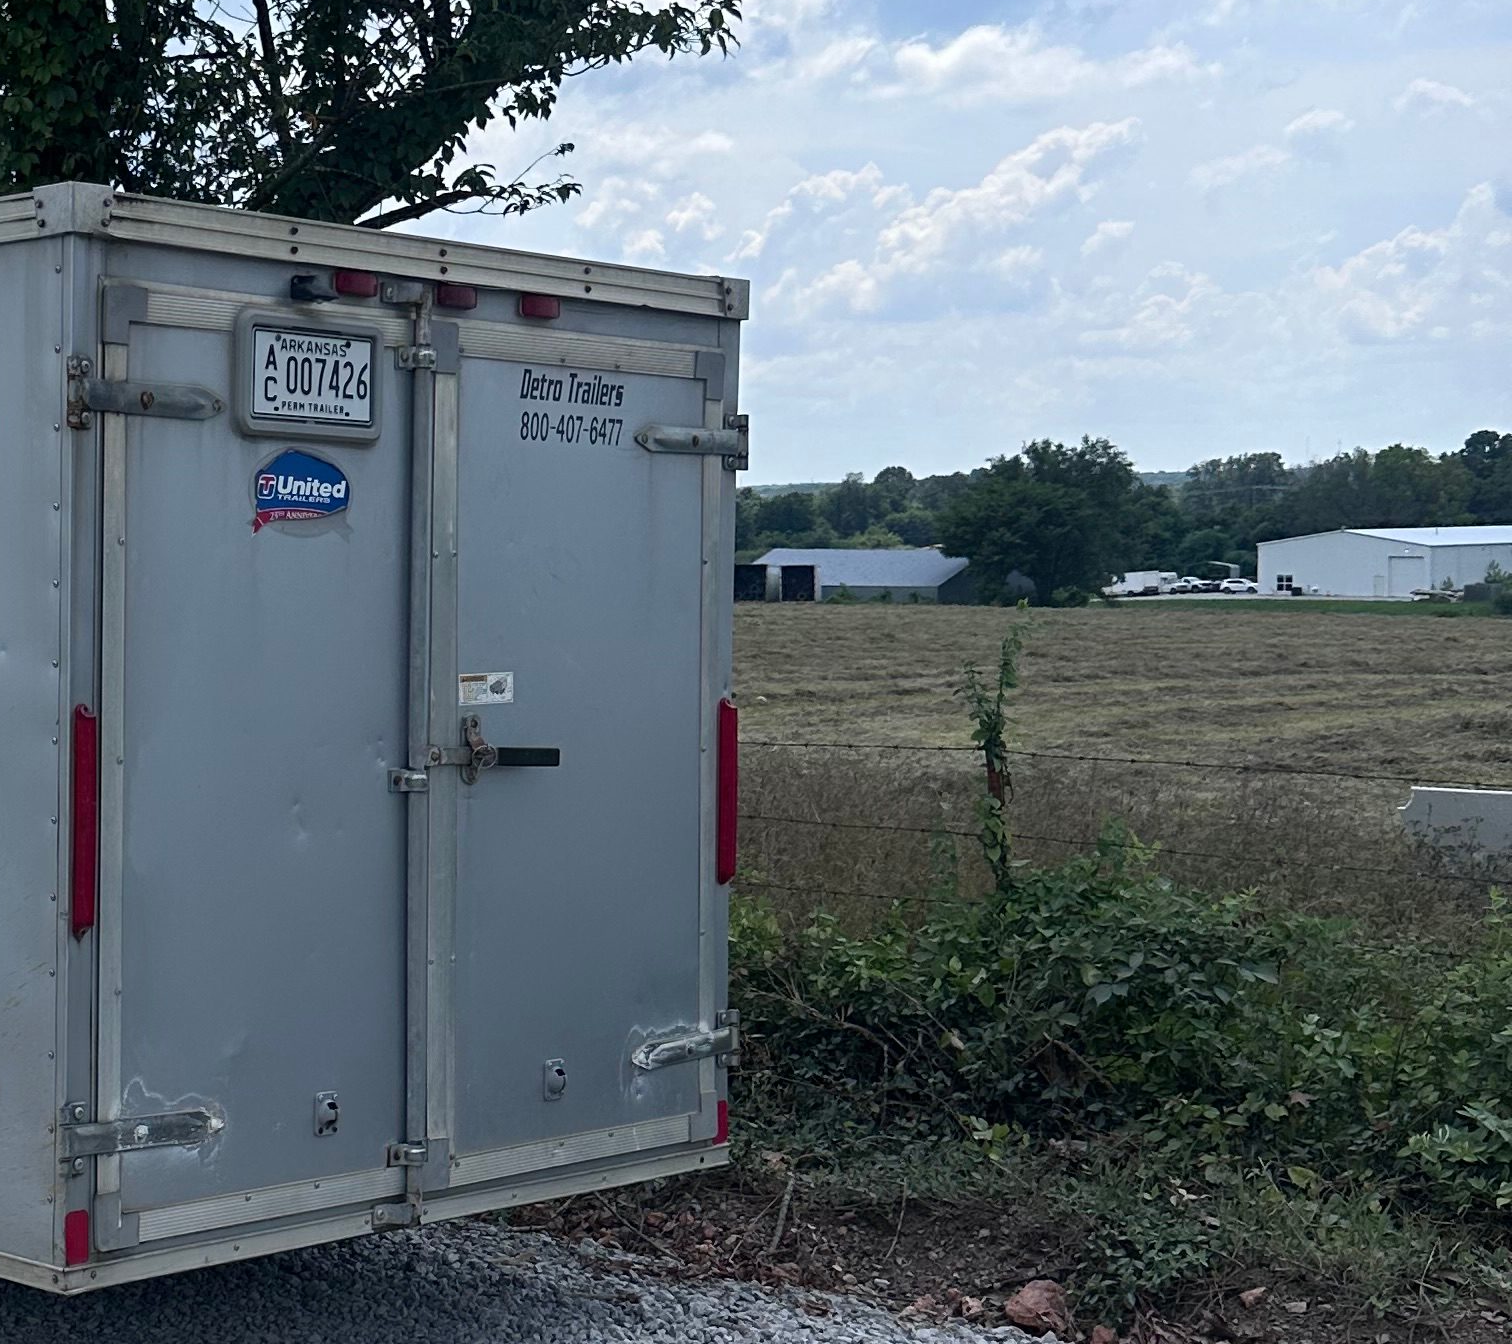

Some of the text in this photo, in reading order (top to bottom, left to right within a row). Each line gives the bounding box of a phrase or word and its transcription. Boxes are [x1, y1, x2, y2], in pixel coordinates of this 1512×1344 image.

[280, 338, 347, 358] ARKANSAS
[286, 355, 369, 400] 007426
[519, 368, 625, 407] Detro Trailers
[281, 400, 345, 415] PERM TRAILER
[520, 411, 623, 447] 800-407-6477
[277, 475, 347, 499] United
[277, 493, 331, 504] TRAILERS
